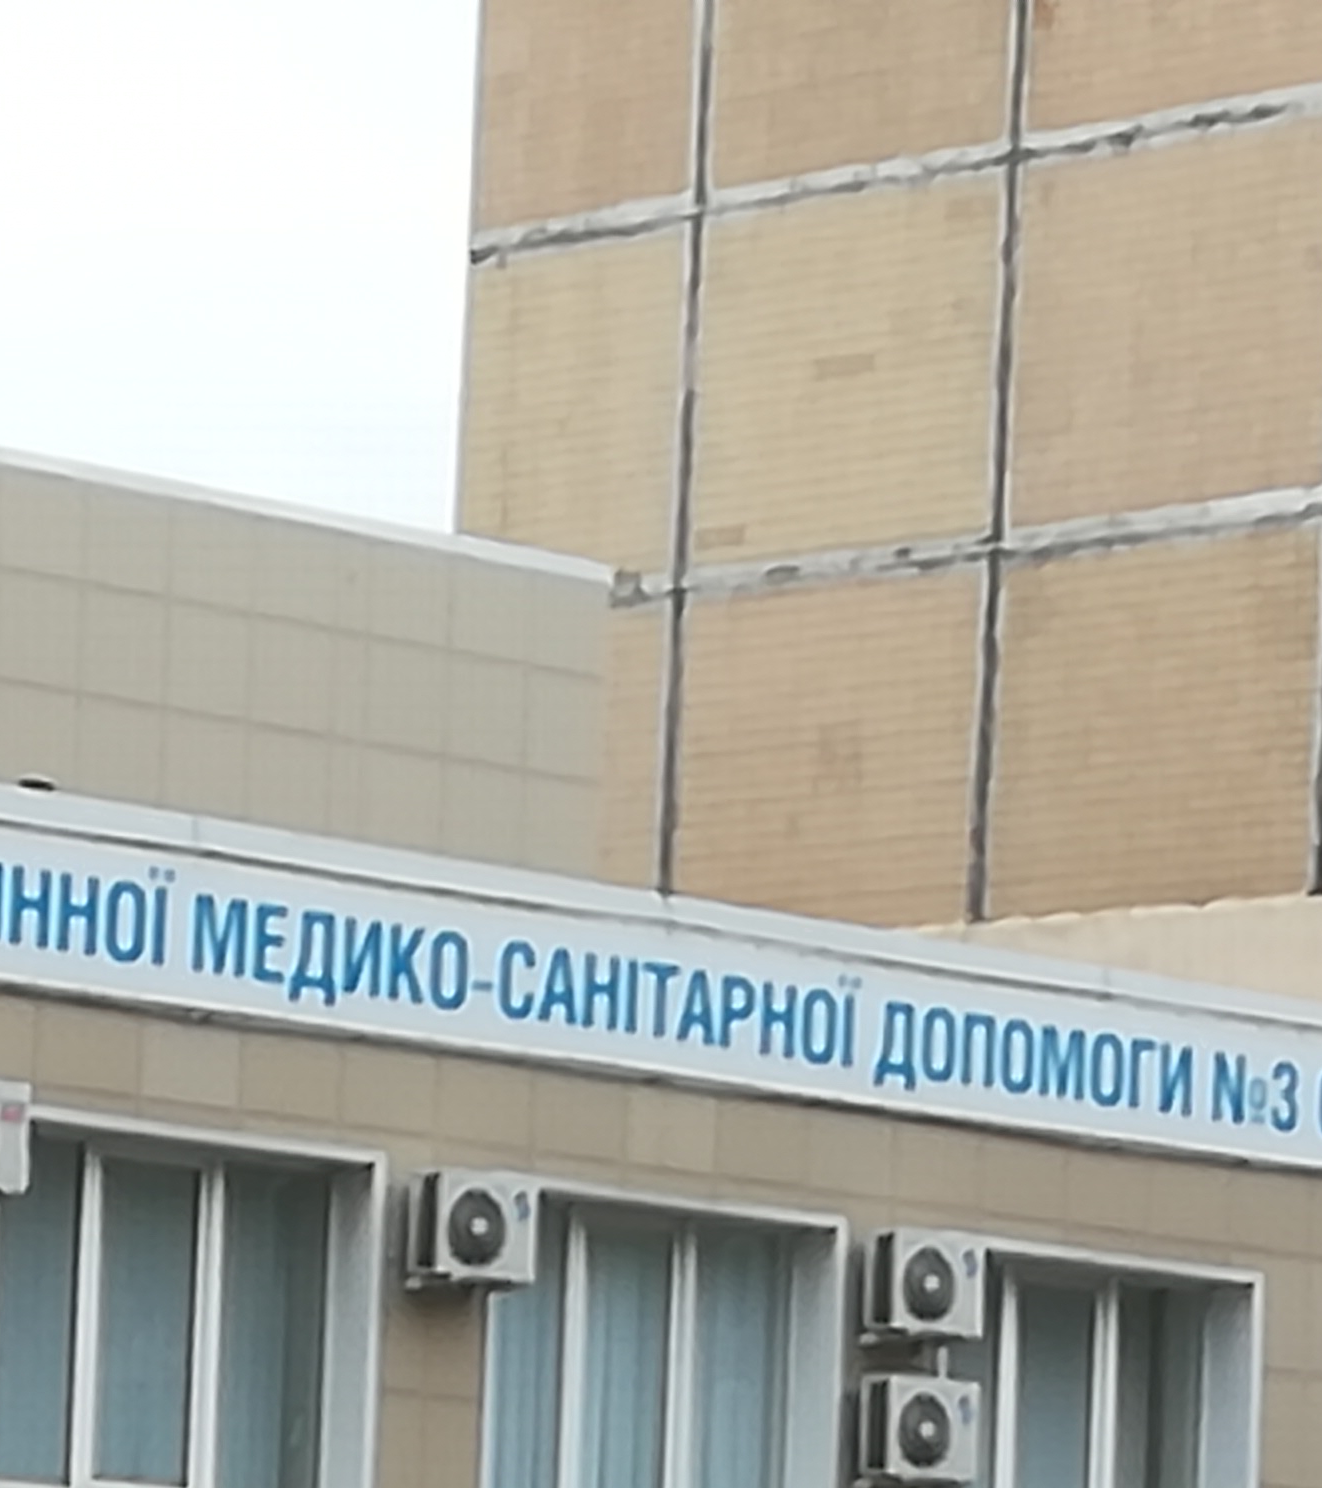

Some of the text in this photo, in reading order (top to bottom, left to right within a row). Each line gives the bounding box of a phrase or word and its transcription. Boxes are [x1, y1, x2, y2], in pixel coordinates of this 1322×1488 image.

[192, 893, 862, 1068] МЕДИКО-САНІТАРНОЇ
[874, 1001, 1192, 1116] ДОПОМОГИ
[1212, 1052, 1298, 1132] №3
